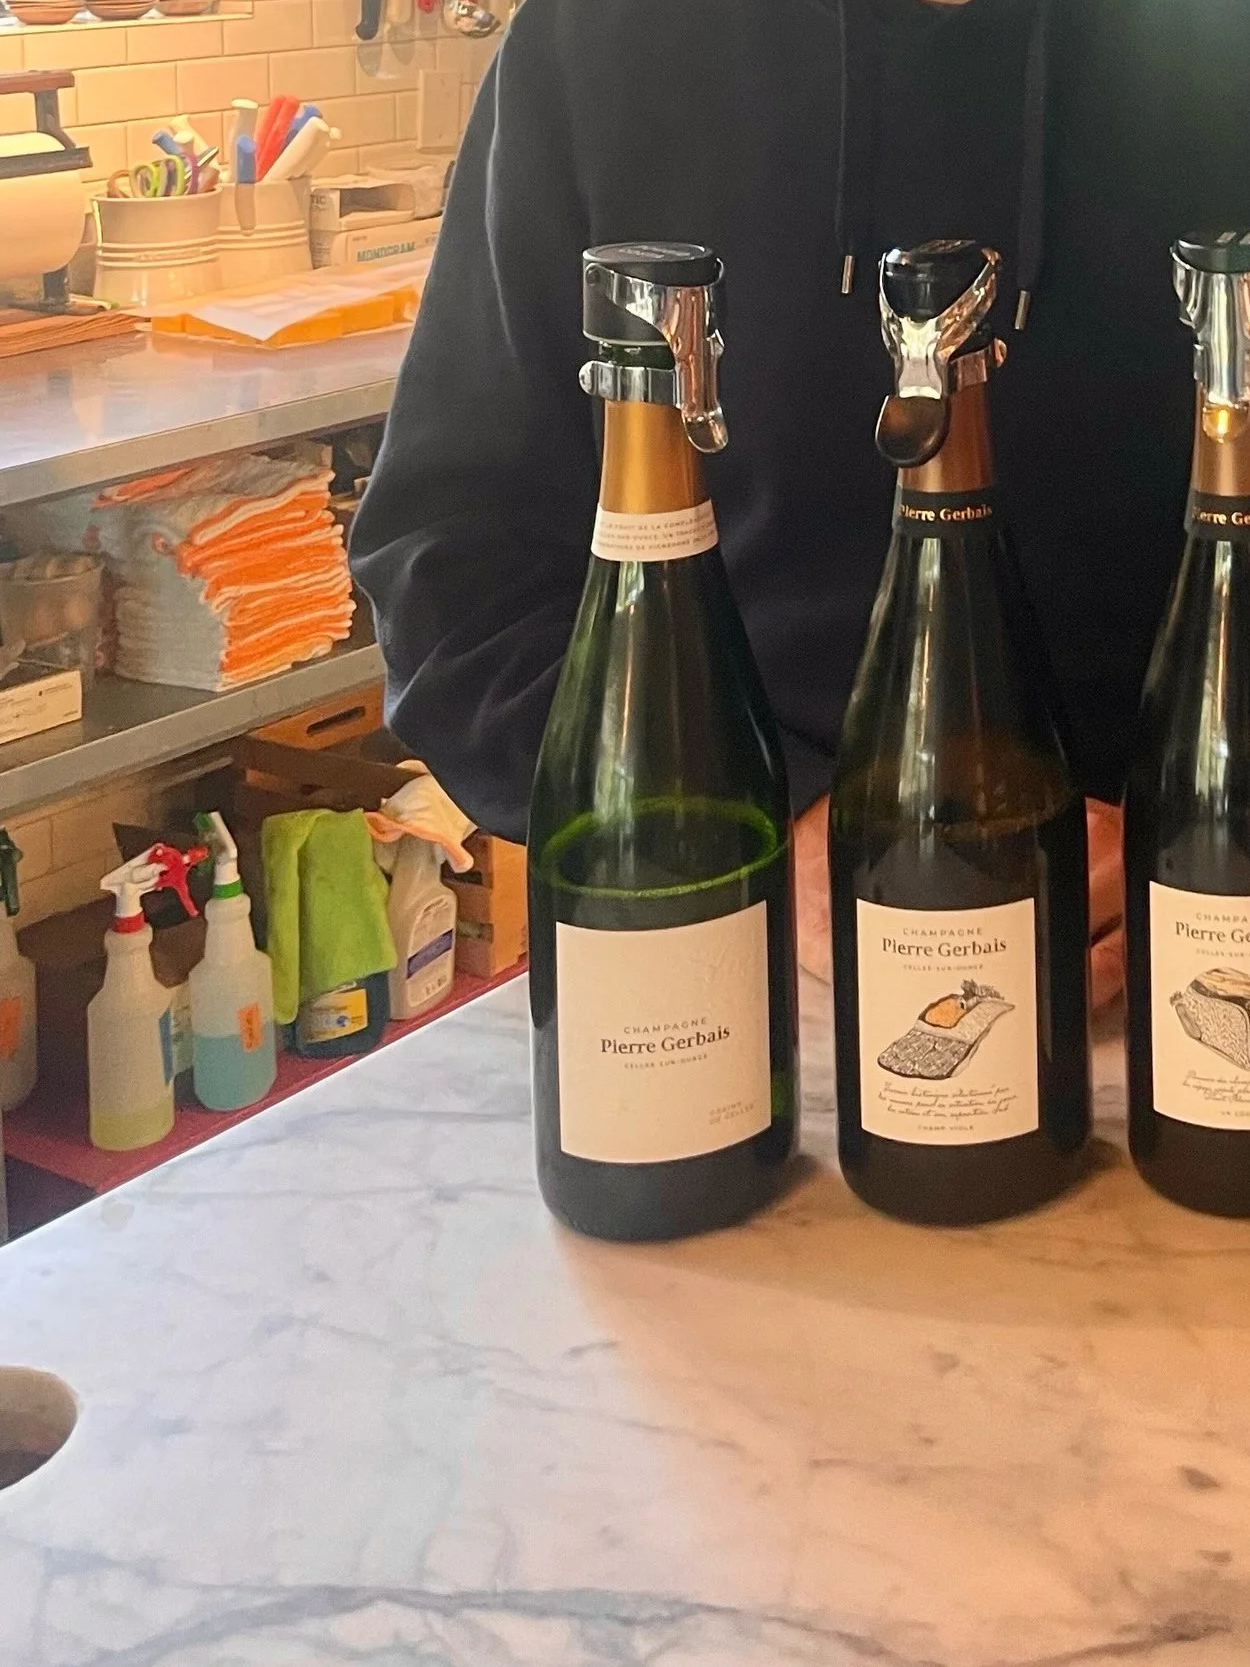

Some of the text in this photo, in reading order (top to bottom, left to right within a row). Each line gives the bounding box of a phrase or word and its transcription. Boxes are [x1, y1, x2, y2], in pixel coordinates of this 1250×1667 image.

[357, 241, 416, 263] MONOGRAM
[939, 503, 993, 521] Gerbais
[903, 927, 984, 937] CHAMPAGNE
[1175, 920, 1227, 944] Pierre
[881, 937, 1008, 958] Pierre Gerbais
[624, 1016, 708, 1035] CHAMPAGNE
[600, 1025, 731, 1055] Pierre Gerbais
